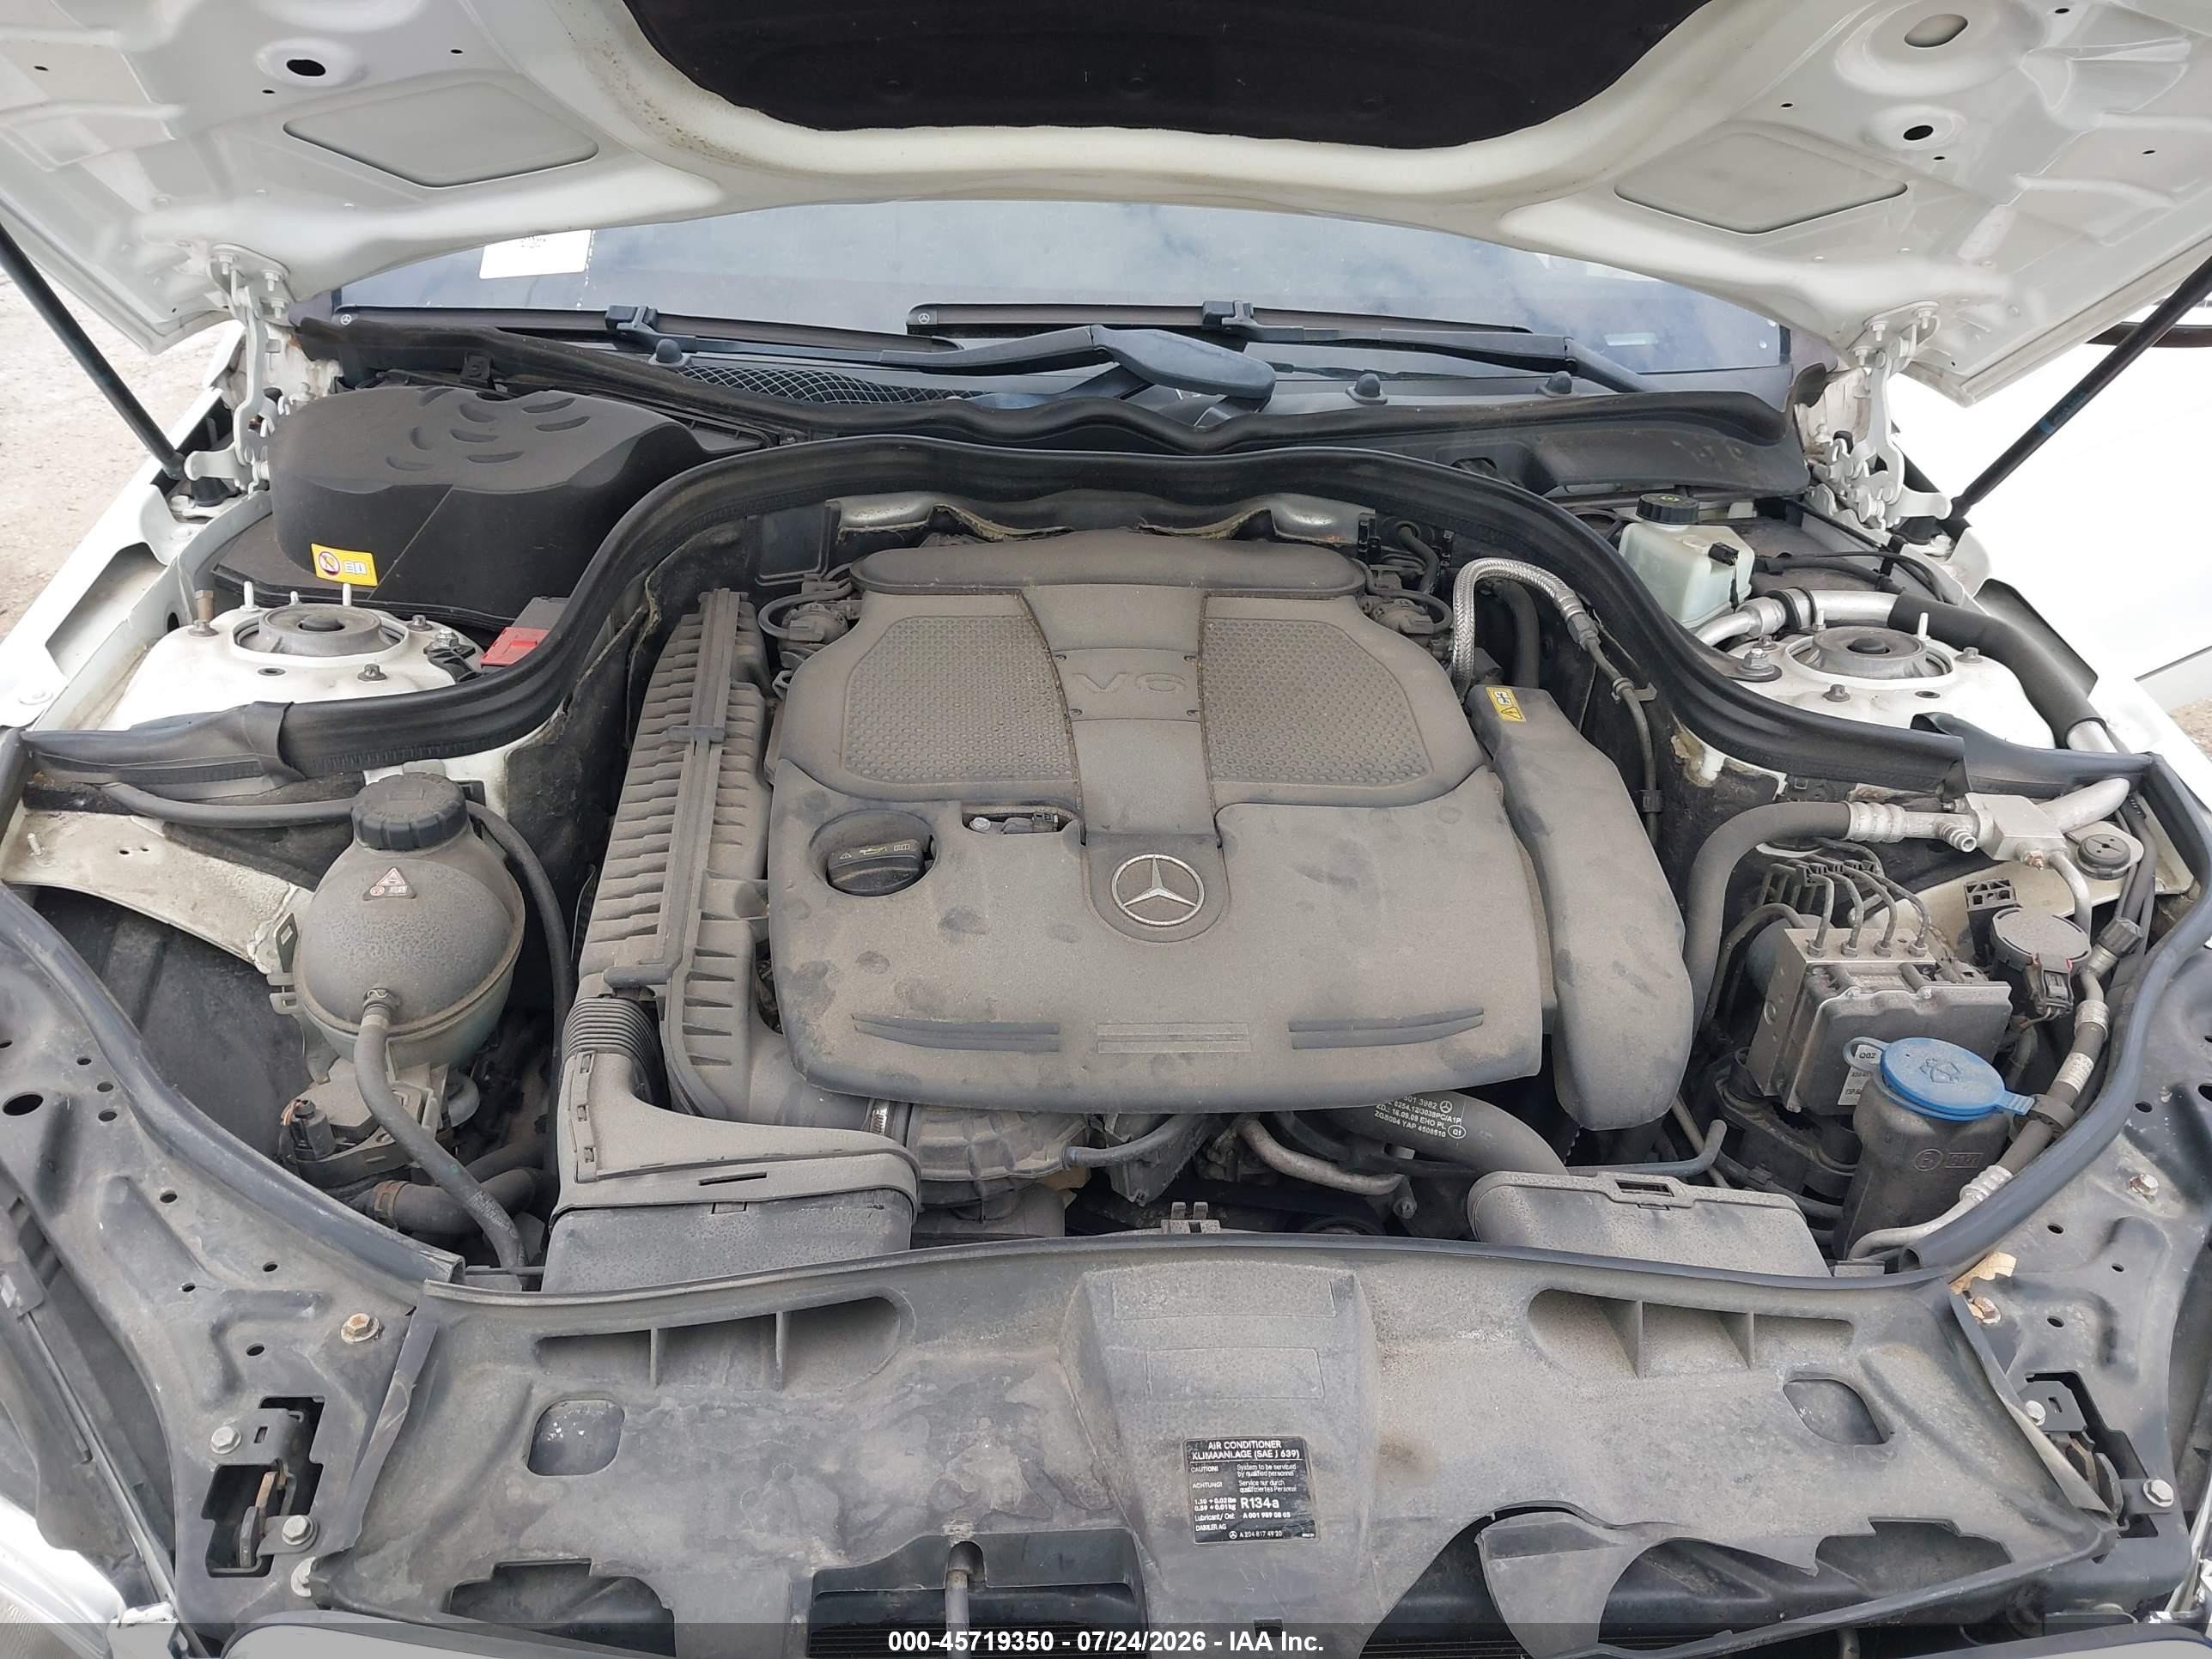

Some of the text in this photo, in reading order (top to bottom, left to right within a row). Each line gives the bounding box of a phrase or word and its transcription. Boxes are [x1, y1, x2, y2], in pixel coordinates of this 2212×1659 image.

[1402, 1121, 1417, 1129] YAP
[1437, 1121, 1447, 1130] PL
[1208, 1440, 1282, 1450] AIR CONDITIONER
[1192, 1449, 1252, 1460] KLIMAANLAGE
[1255, 1449, 1273, 1460] (SAE
[1280, 1449, 1300, 1459] 639)
[1237, 1463, 1258, 1472] System
[1240, 1497, 1279, 1509] R134a
[1195, 1523, 1218, 1532] DAIMLER
